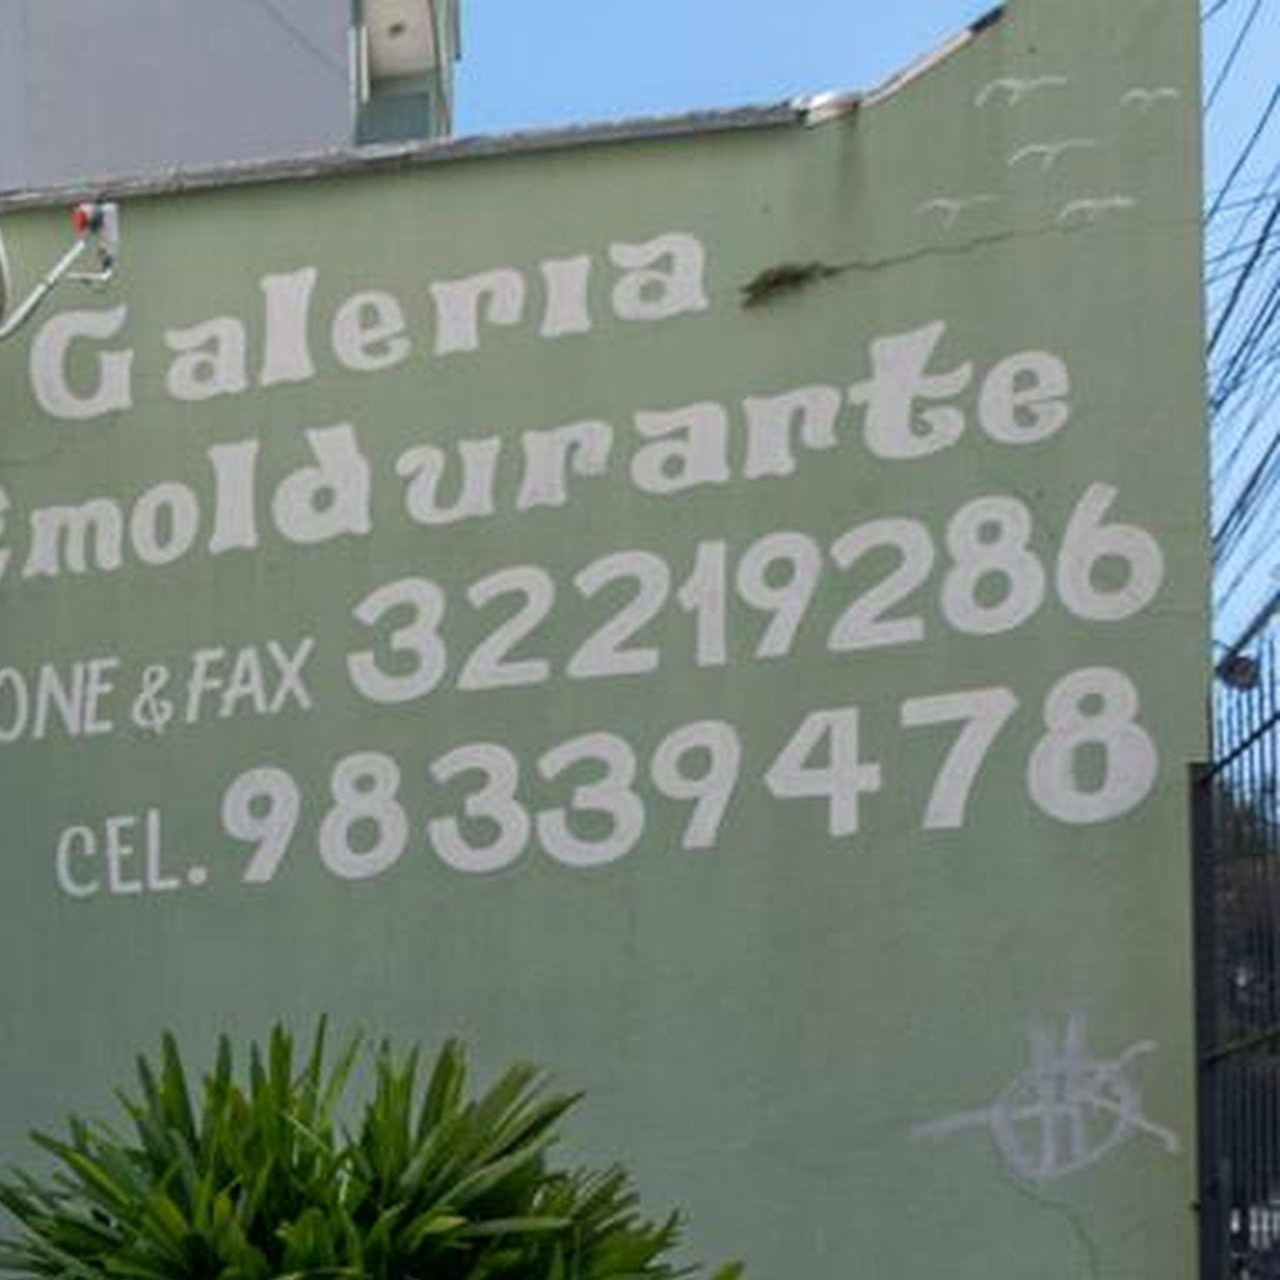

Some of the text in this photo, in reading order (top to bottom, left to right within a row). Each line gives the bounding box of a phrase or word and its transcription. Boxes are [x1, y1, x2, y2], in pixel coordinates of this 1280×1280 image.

[29, 231, 710, 421] Galeria
[185, 637, 316, 725] FAX
[345, 482, 1165, 704] 32219286
[56, 665, 1160, 897] CEL. 98339478
